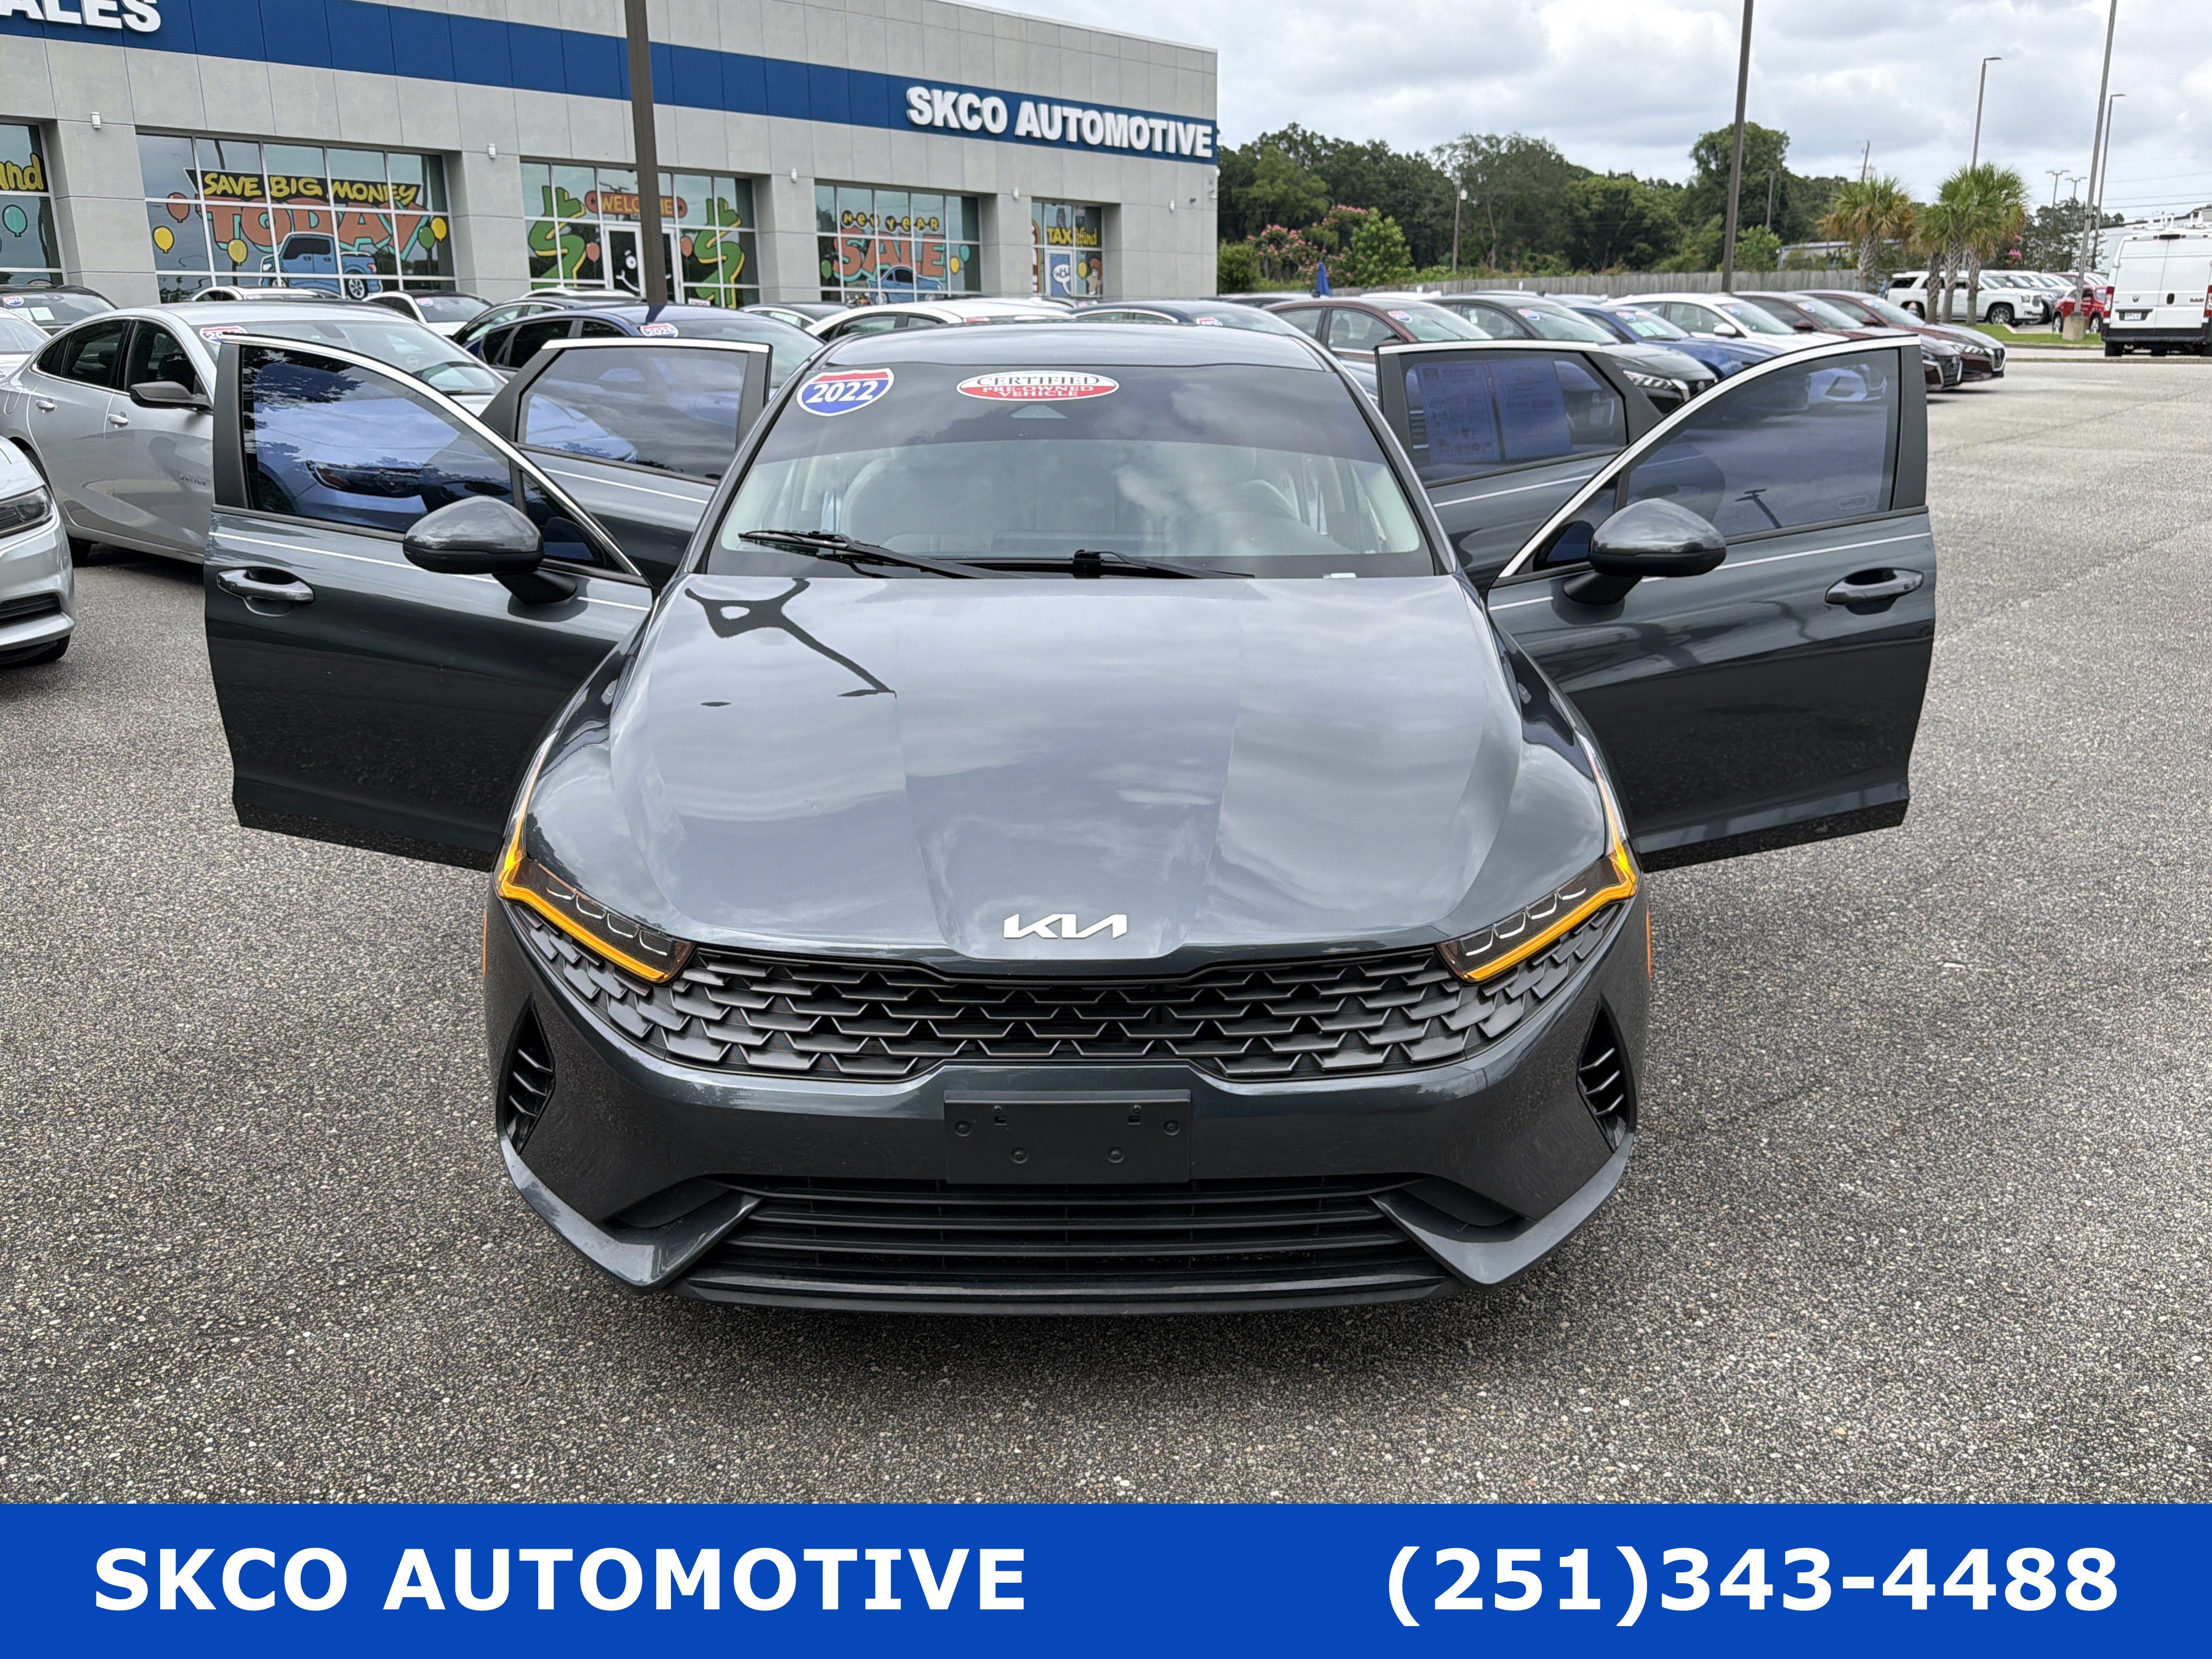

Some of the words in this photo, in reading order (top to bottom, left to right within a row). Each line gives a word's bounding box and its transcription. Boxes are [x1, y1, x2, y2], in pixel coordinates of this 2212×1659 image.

[906, 86, 1007, 134] SKCO
[1014, 101, 1212, 157] AUTOMOTIVE
[204, 172, 262, 196] SAVE
[269, 176, 323, 198] BIG
[327, 180, 417, 205] MONEY
[601, 195, 673, 213] WELCE
[196, 196, 429, 258] TODAY
[1046, 227, 1073, 245] TAX
[833, 225, 945, 279] SALE
[805, 381, 878, 403] 2022
[977, 376, 1100, 386] CERTIFIED
[1003, 913, 1127, 939] KIA
